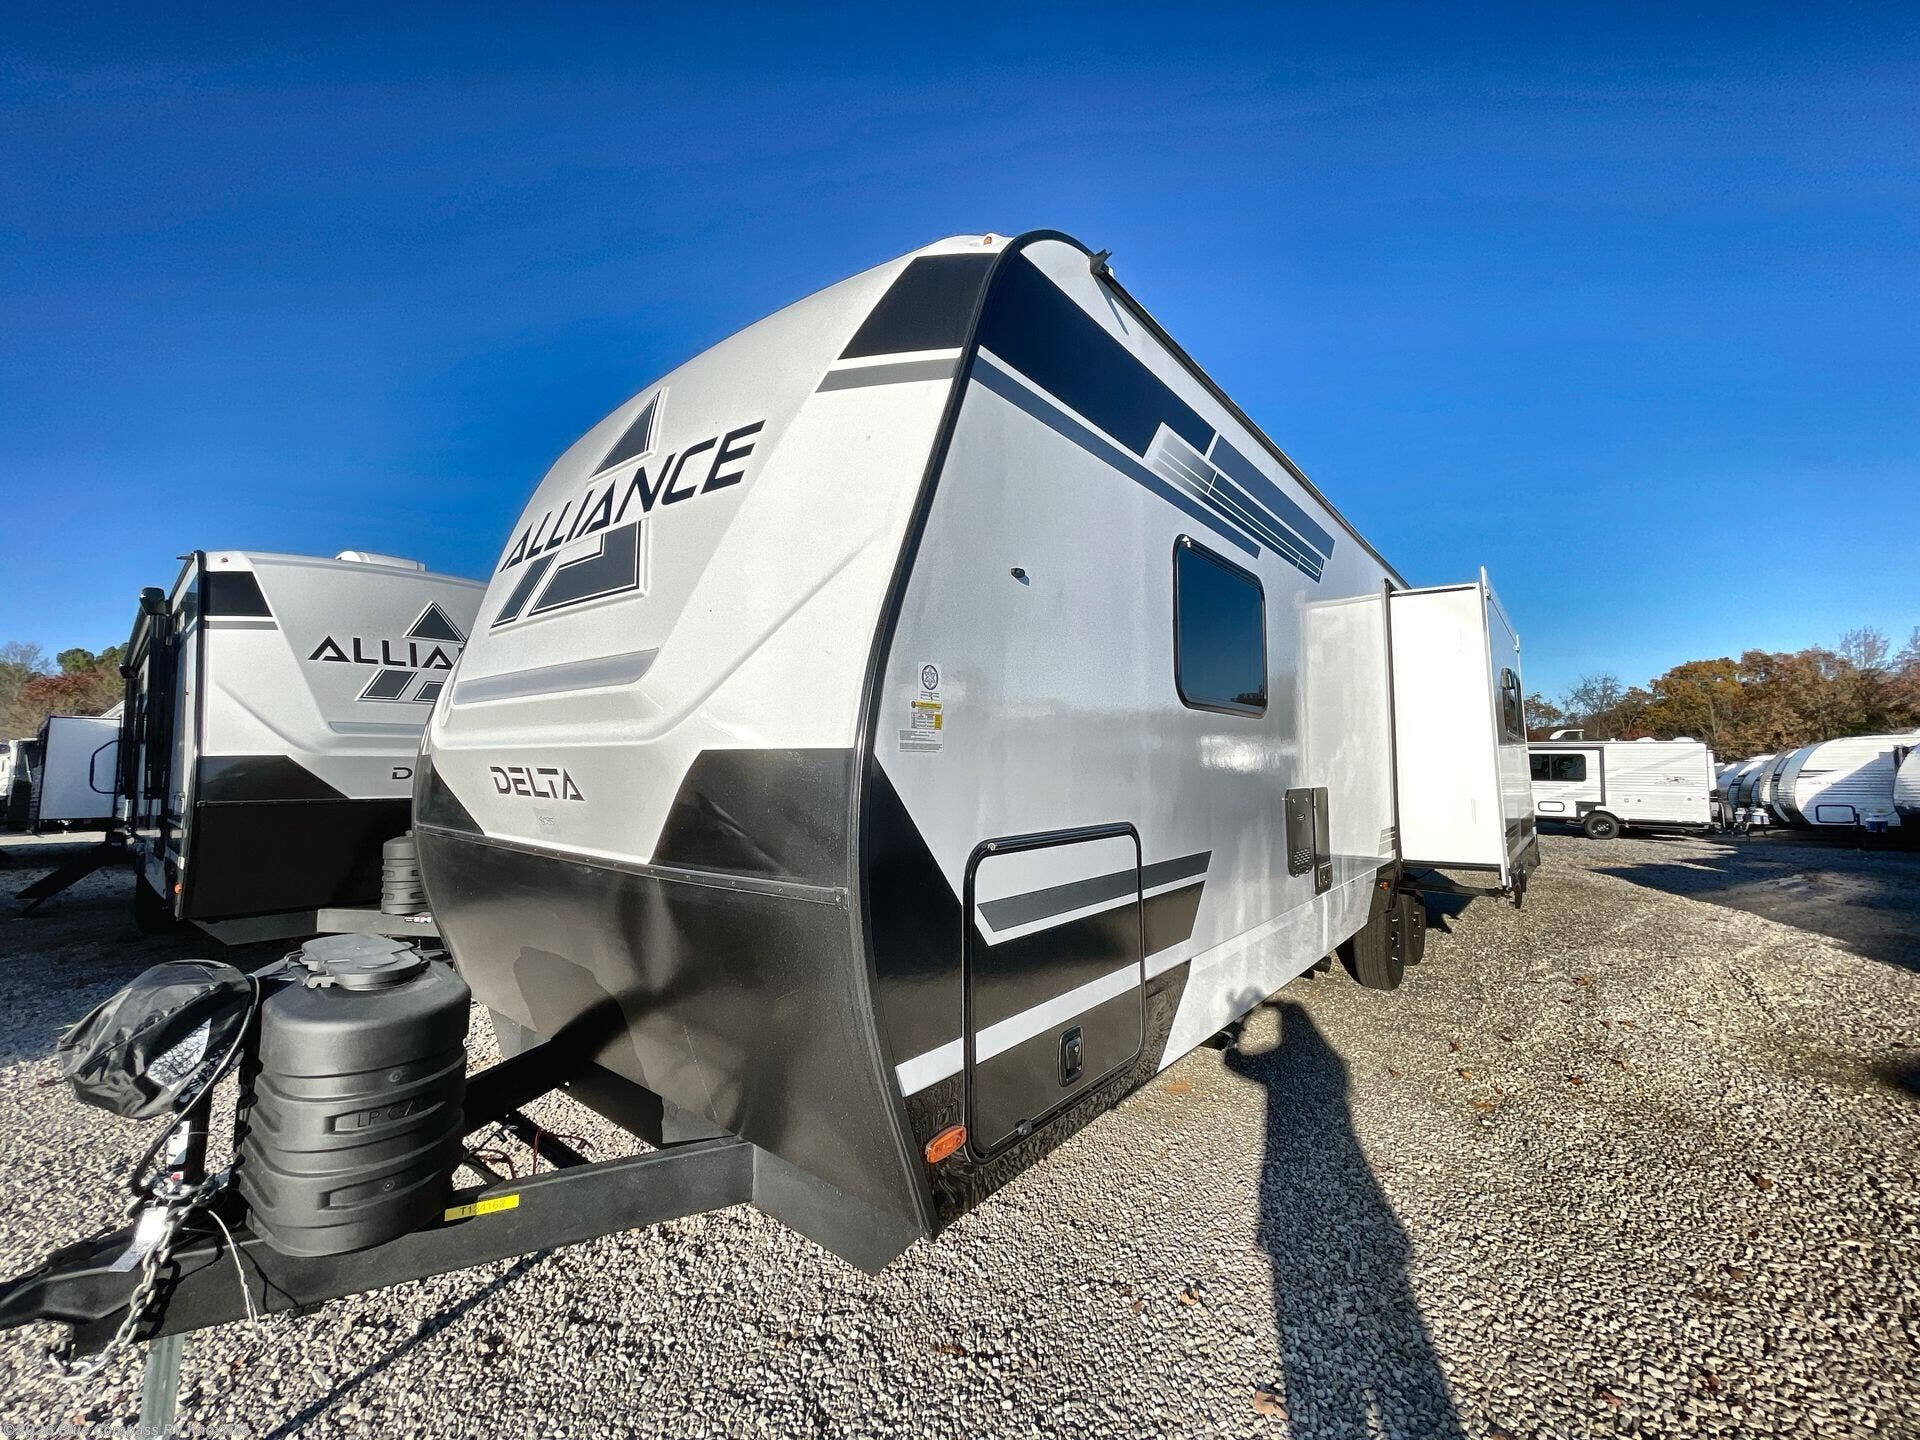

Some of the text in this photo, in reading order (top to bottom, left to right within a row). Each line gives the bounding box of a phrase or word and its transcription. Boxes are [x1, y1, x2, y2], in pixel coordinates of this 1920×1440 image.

[499, 419, 767, 573] ALLIANCE
[307, 635, 464, 670] ALLIA
[489, 766, 586, 801] DELTA
